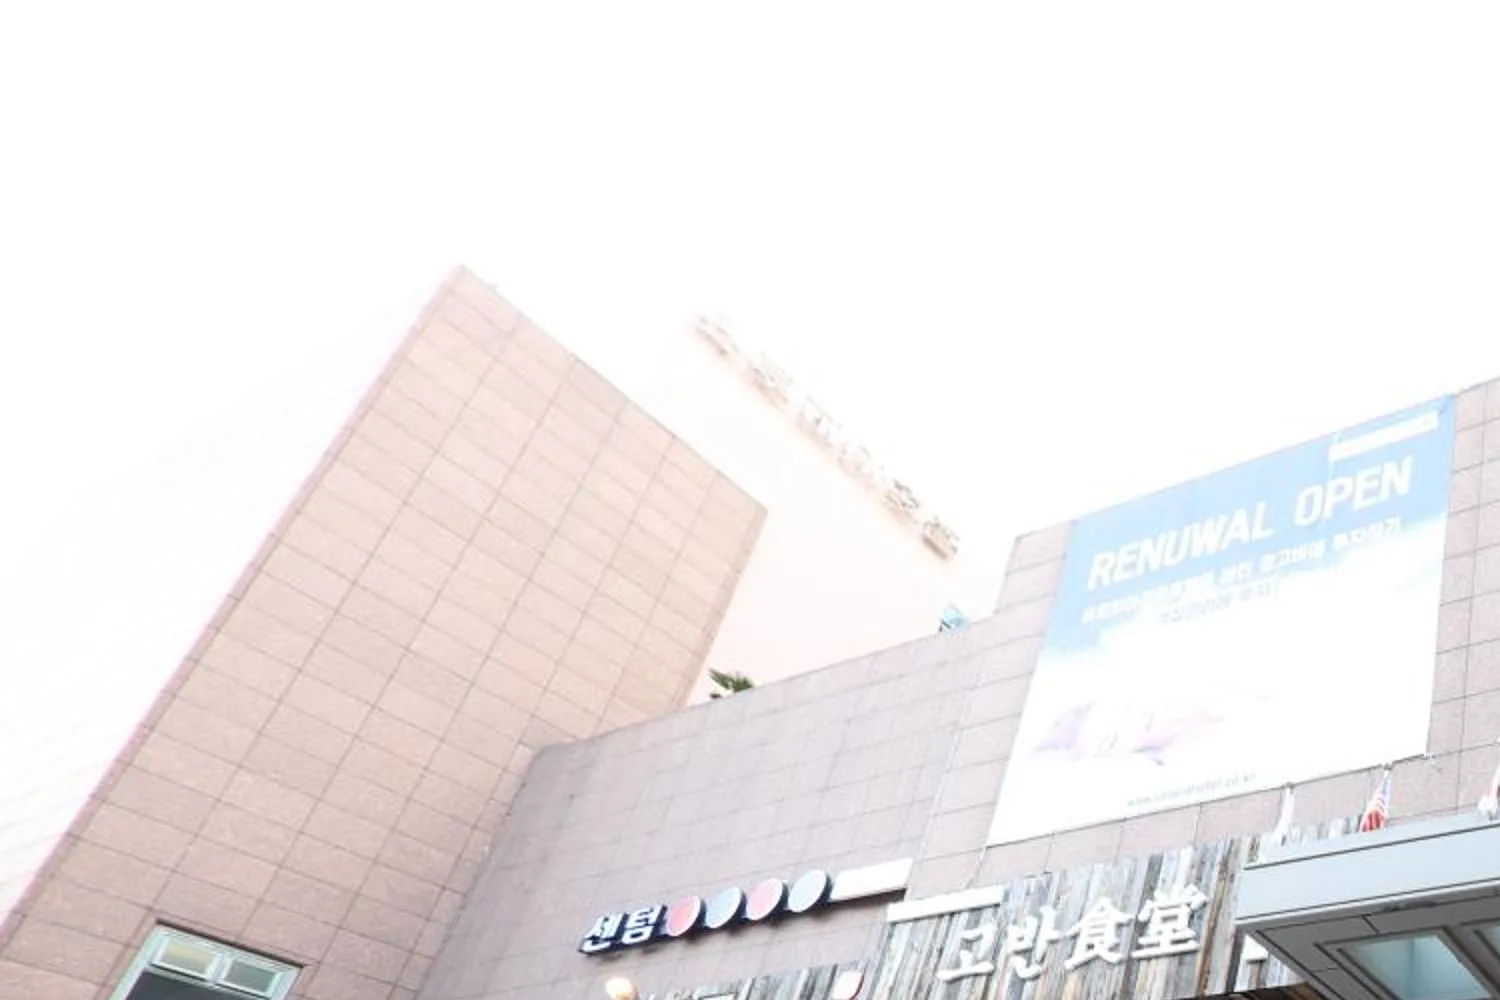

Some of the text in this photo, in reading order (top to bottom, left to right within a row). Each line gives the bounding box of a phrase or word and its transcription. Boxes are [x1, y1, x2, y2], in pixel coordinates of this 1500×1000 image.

[1087, 501, 1275, 591] RENUWAL
[1293, 455, 1414, 528] OPEN
[580, 905, 665, 953] 센텀
[936, 883, 1209, 984] 고반食堂
